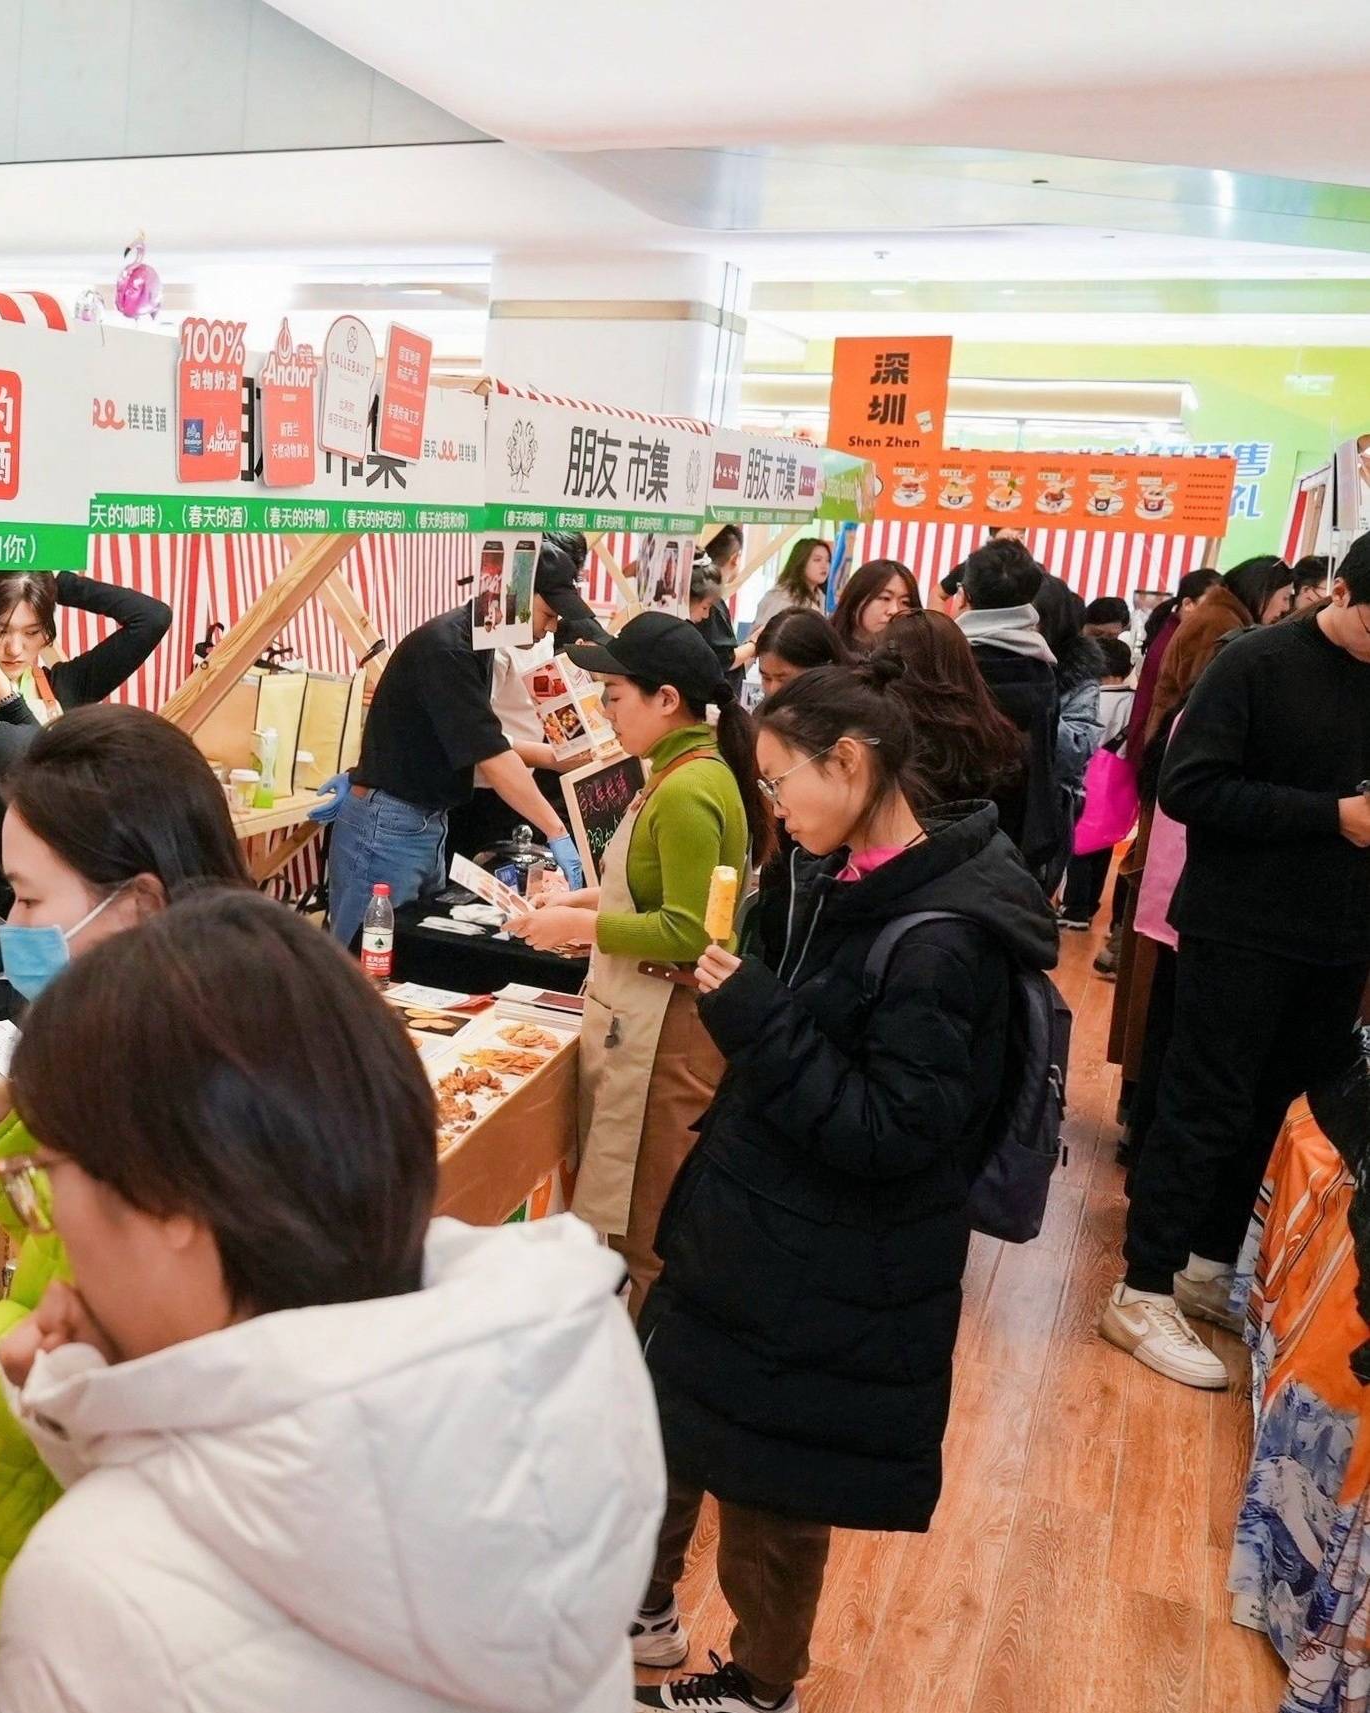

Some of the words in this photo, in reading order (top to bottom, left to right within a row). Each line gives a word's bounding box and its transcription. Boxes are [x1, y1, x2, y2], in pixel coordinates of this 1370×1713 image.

[184, 324, 245, 365] 100%
[189, 368, 238, 392] 动物奶油
[263, 353, 313, 388] Anchor
[867, 352, 910, 426] 深圳
[847, 435, 881, 448] Shen
[885, 436, 921, 448] Zhen
[563, 425, 622, 501] 朋友
[625, 434, 671, 503] 市集
[743, 447, 774, 500] 朋友
[774, 451, 797, 502] 市集
